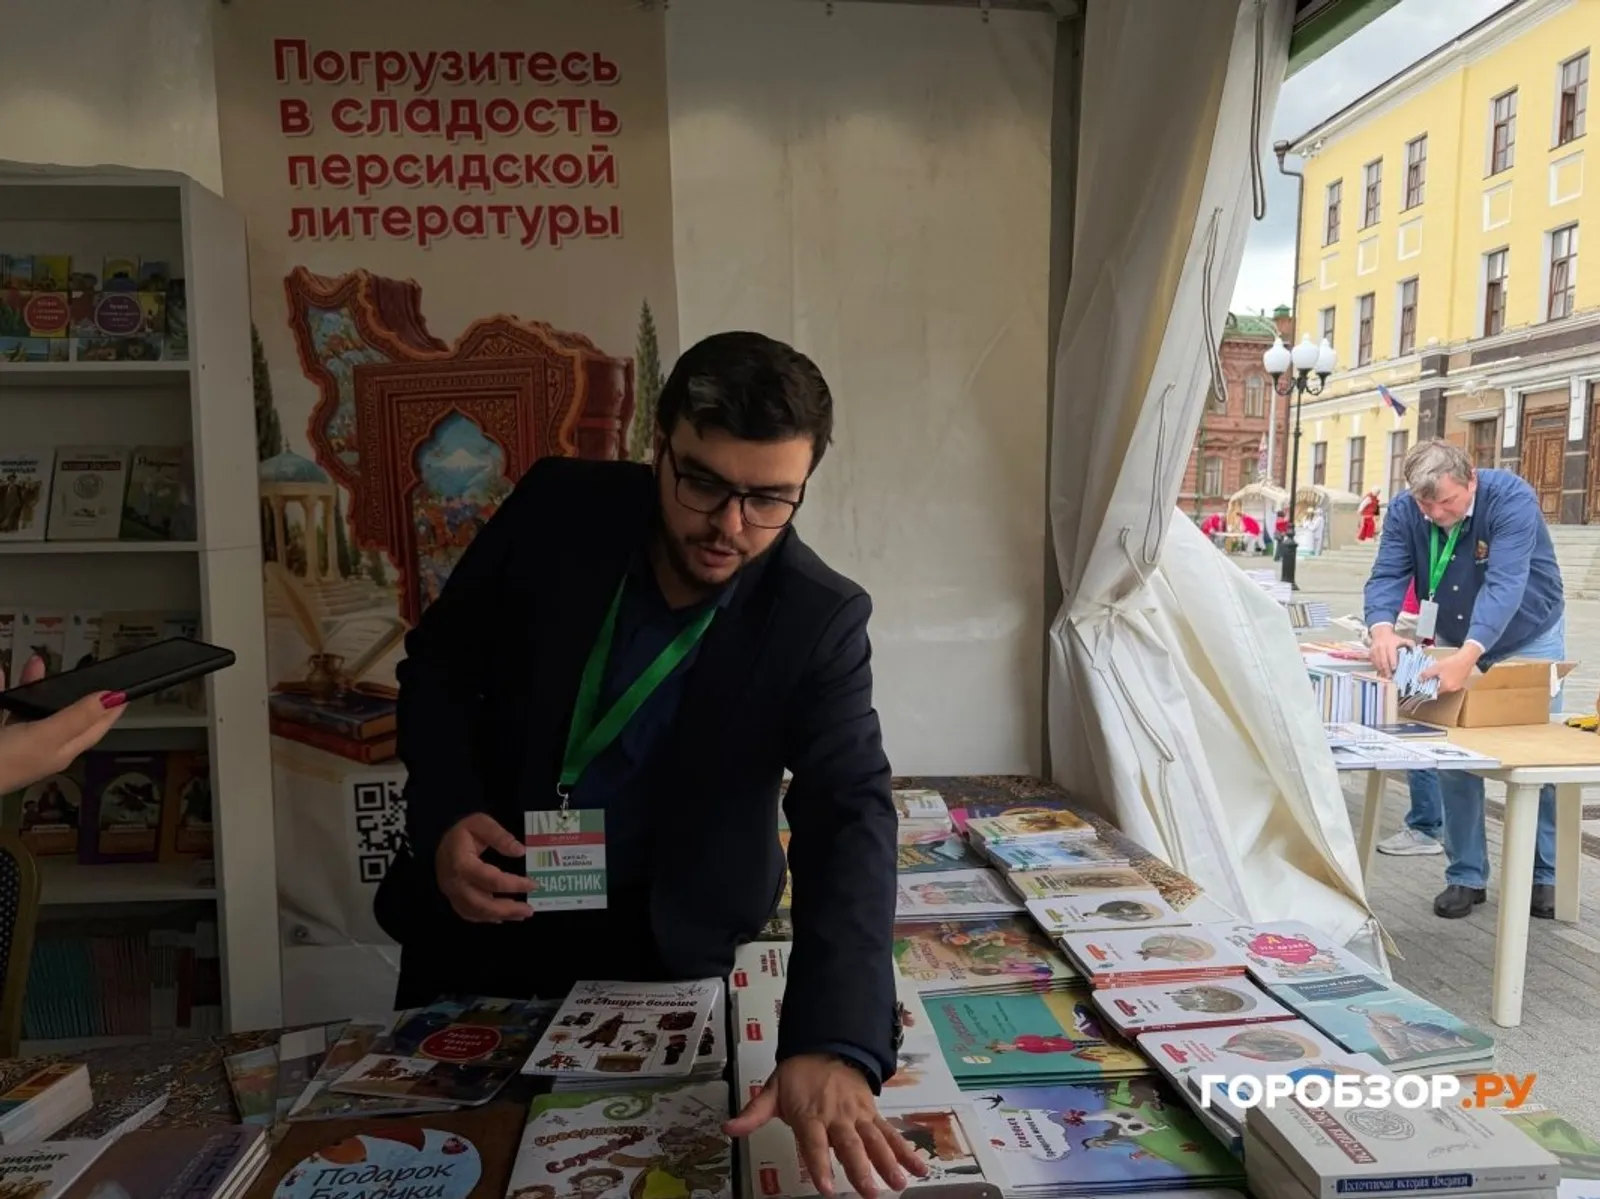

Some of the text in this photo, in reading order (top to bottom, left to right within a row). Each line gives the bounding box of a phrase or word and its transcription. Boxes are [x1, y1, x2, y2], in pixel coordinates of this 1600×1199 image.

[274, 39, 618, 92] Погрузитесь
[279, 97, 619, 141] в сладость
[287, 144, 617, 194] персидской
[288, 203, 621, 245] литературы
[646, 998, 697, 1007] больше
[312, 1163, 456, 1188] Подарок
